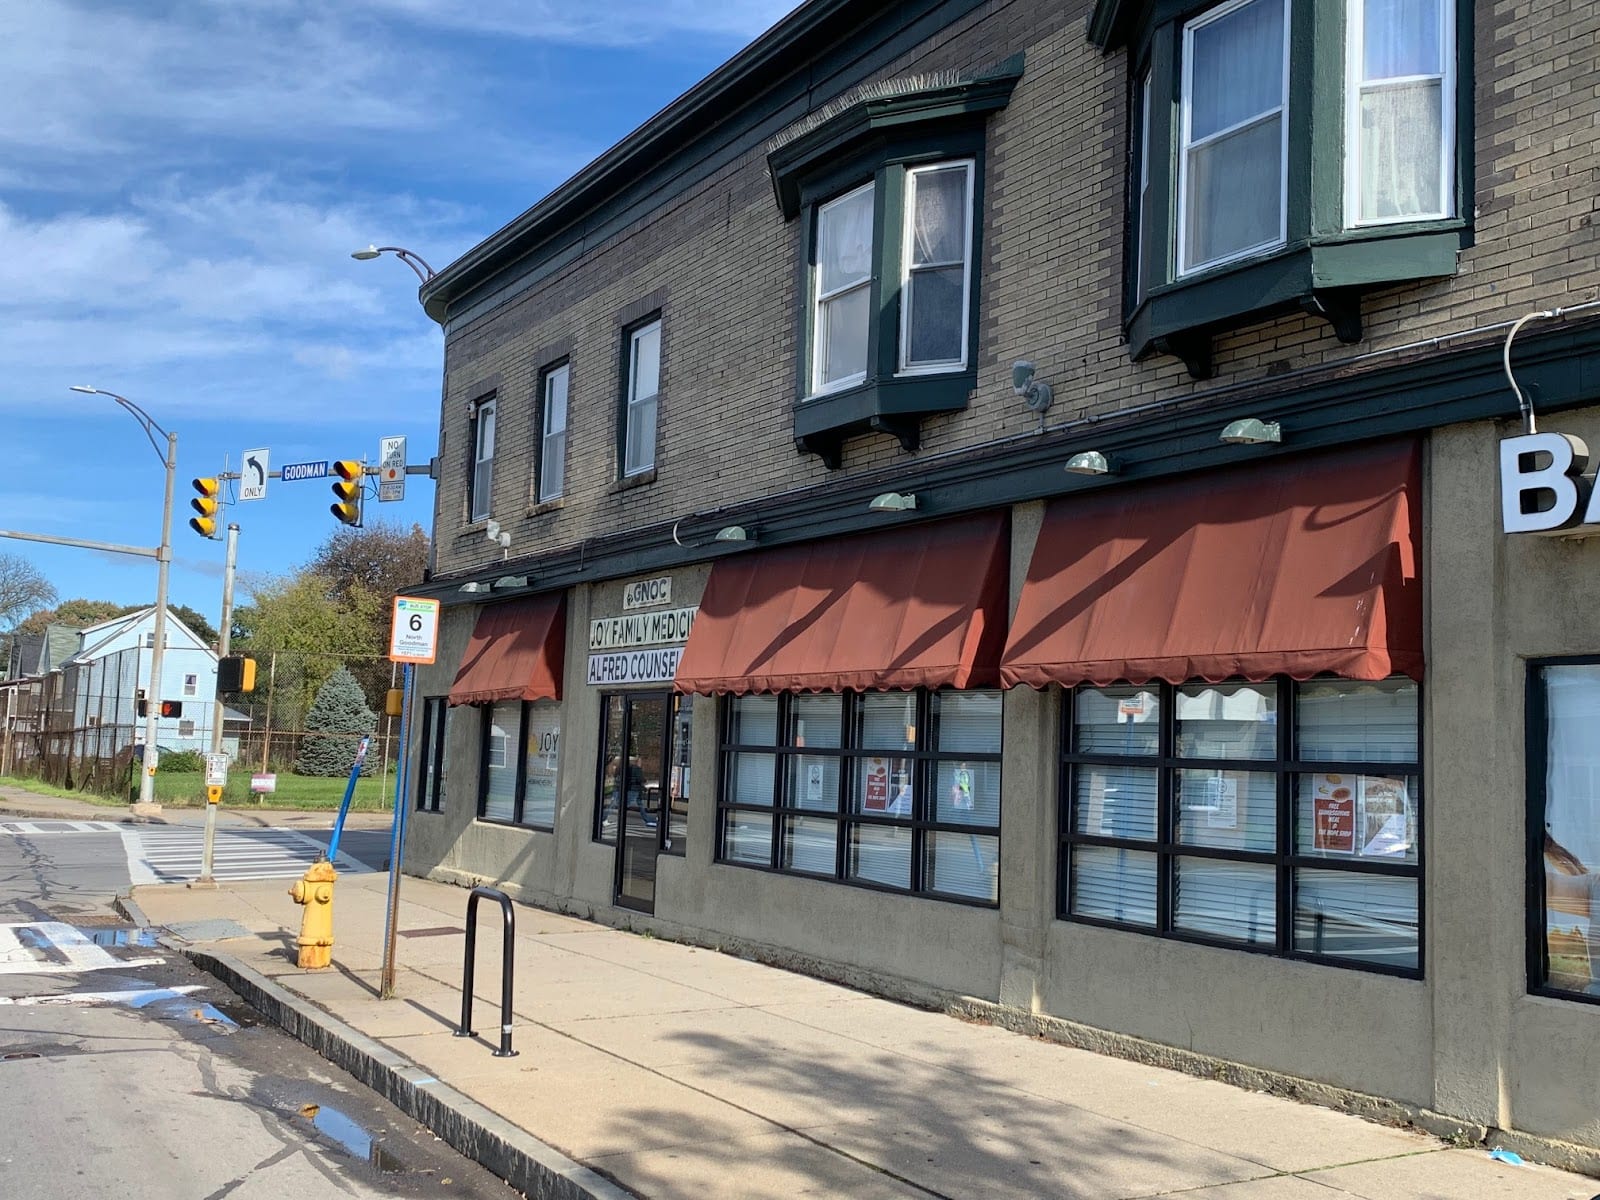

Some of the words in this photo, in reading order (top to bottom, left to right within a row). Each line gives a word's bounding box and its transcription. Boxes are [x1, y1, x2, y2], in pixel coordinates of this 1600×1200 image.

[387, 440, 399, 450] NO
[382, 460, 391, 469] ON
[391, 459, 404, 468] RED
[386, 451, 401, 460] TURN
[284, 463, 326, 480] GOODMAN
[1499, 432, 1600, 533] B
[244, 486, 263, 498] ONLY
[634, 579, 667, 602] GNOC
[409, 614, 422, 631] 6
[591, 622, 609, 647] JOY
[612, 615, 650, 645] FAMILY
[589, 655, 628, 681] ALFRED
[539, 731, 559, 752] JOY
